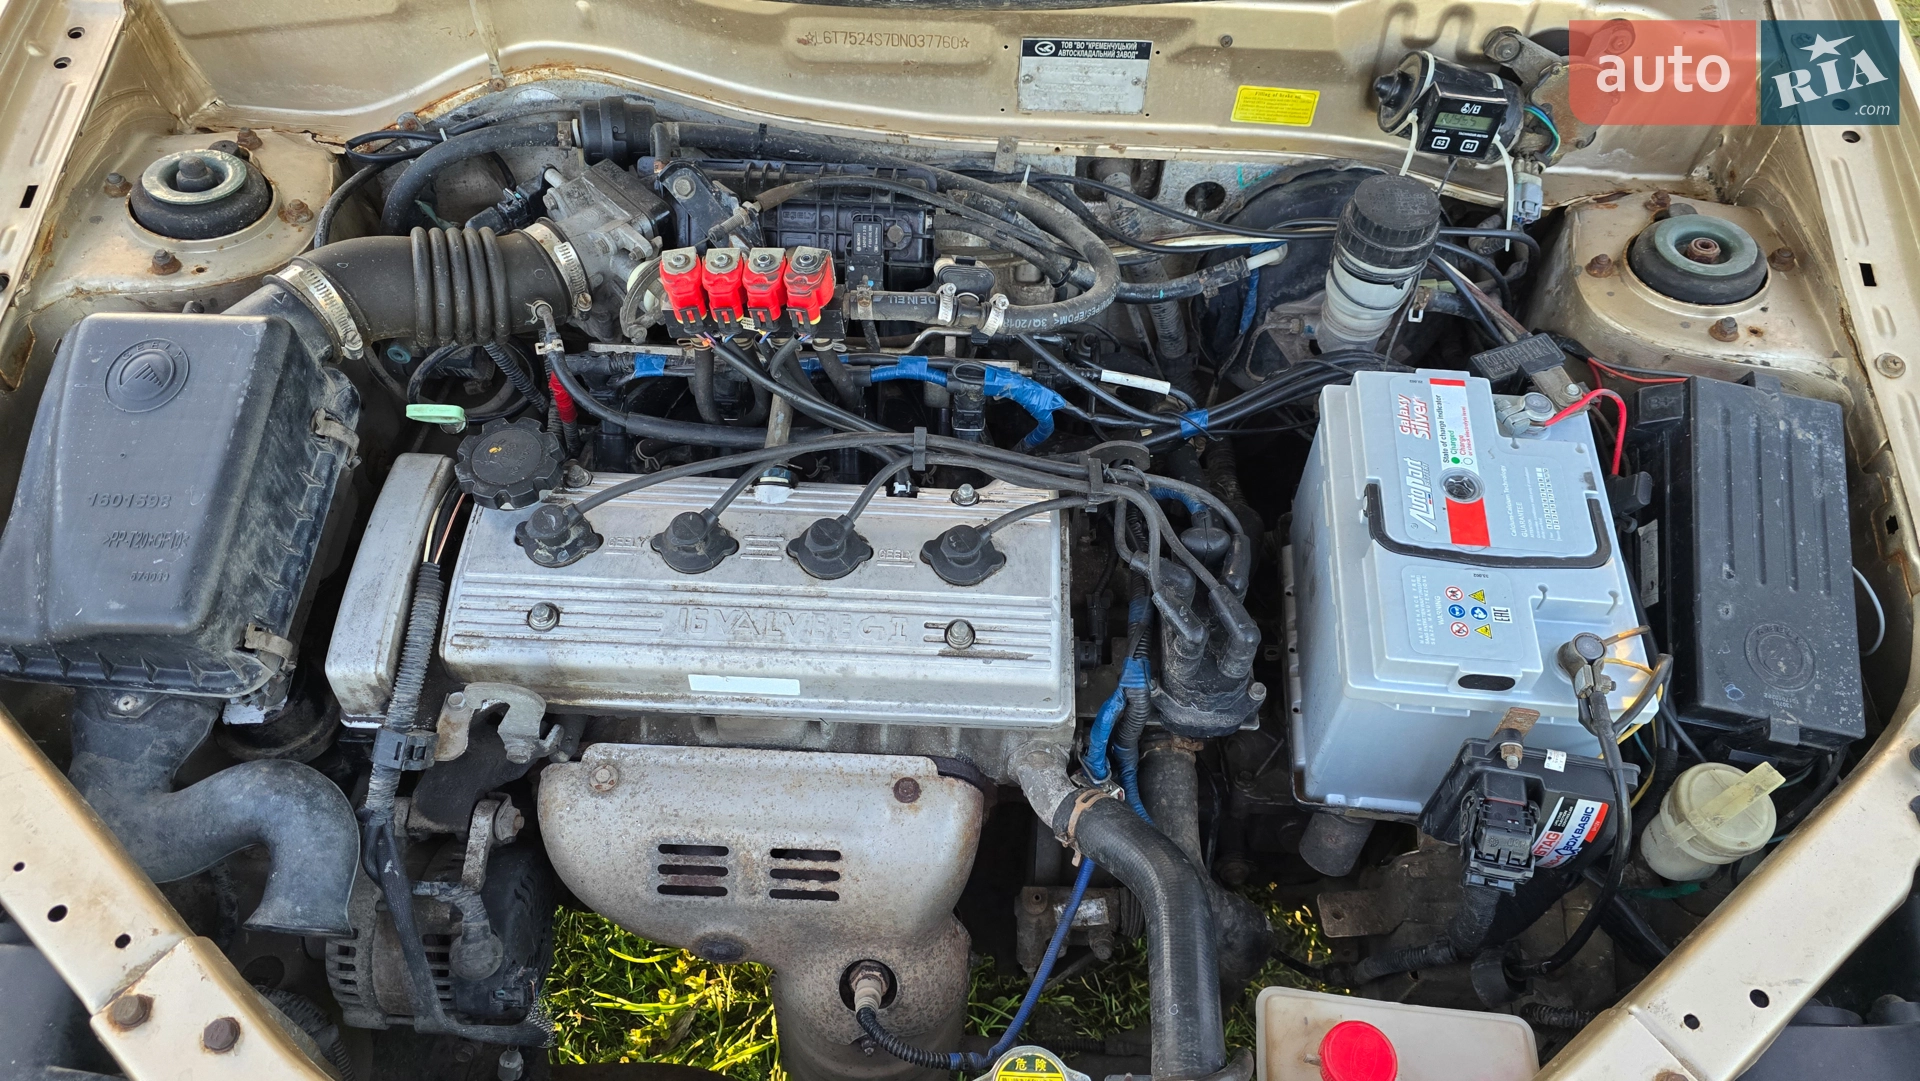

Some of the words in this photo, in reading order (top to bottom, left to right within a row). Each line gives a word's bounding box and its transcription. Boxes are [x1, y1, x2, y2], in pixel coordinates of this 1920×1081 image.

[1057, 49, 1116, 58] АВТОСКЛАДАЛЬНИЙ
[1115, 50, 1139, 59] ЗАВОД"
[1060, 41, 1073, 49] ТОВ
[1086, 42, 1138, 51] "КРЕМЕНЧУЦЬКИЙ
[907, 295, 918, 305] IN
[121, 340, 182, 361] GEELY
[1396, 394, 1412, 435] Galaxy
[1411, 400, 1431, 440] Silver
[1439, 421, 1447, 440] charge
[1449, 430, 1457, 454] Charged
[1442, 449, 1450, 463] State
[1501, 465, 1509, 493] Technology
[1403, 457, 1438, 532] AutoPart
[1505, 493, 1517, 536] Calcium-Calcium
[1516, 502, 1528, 537] GUARANTEE
[607, 536, 649, 549] GEELY
[878, 549, 915, 561] GEELY
[1435, 596, 1444, 625] WARNING
[1574, 806, 1594, 836] BASIC
[1533, 830, 1560, 856] STAG
